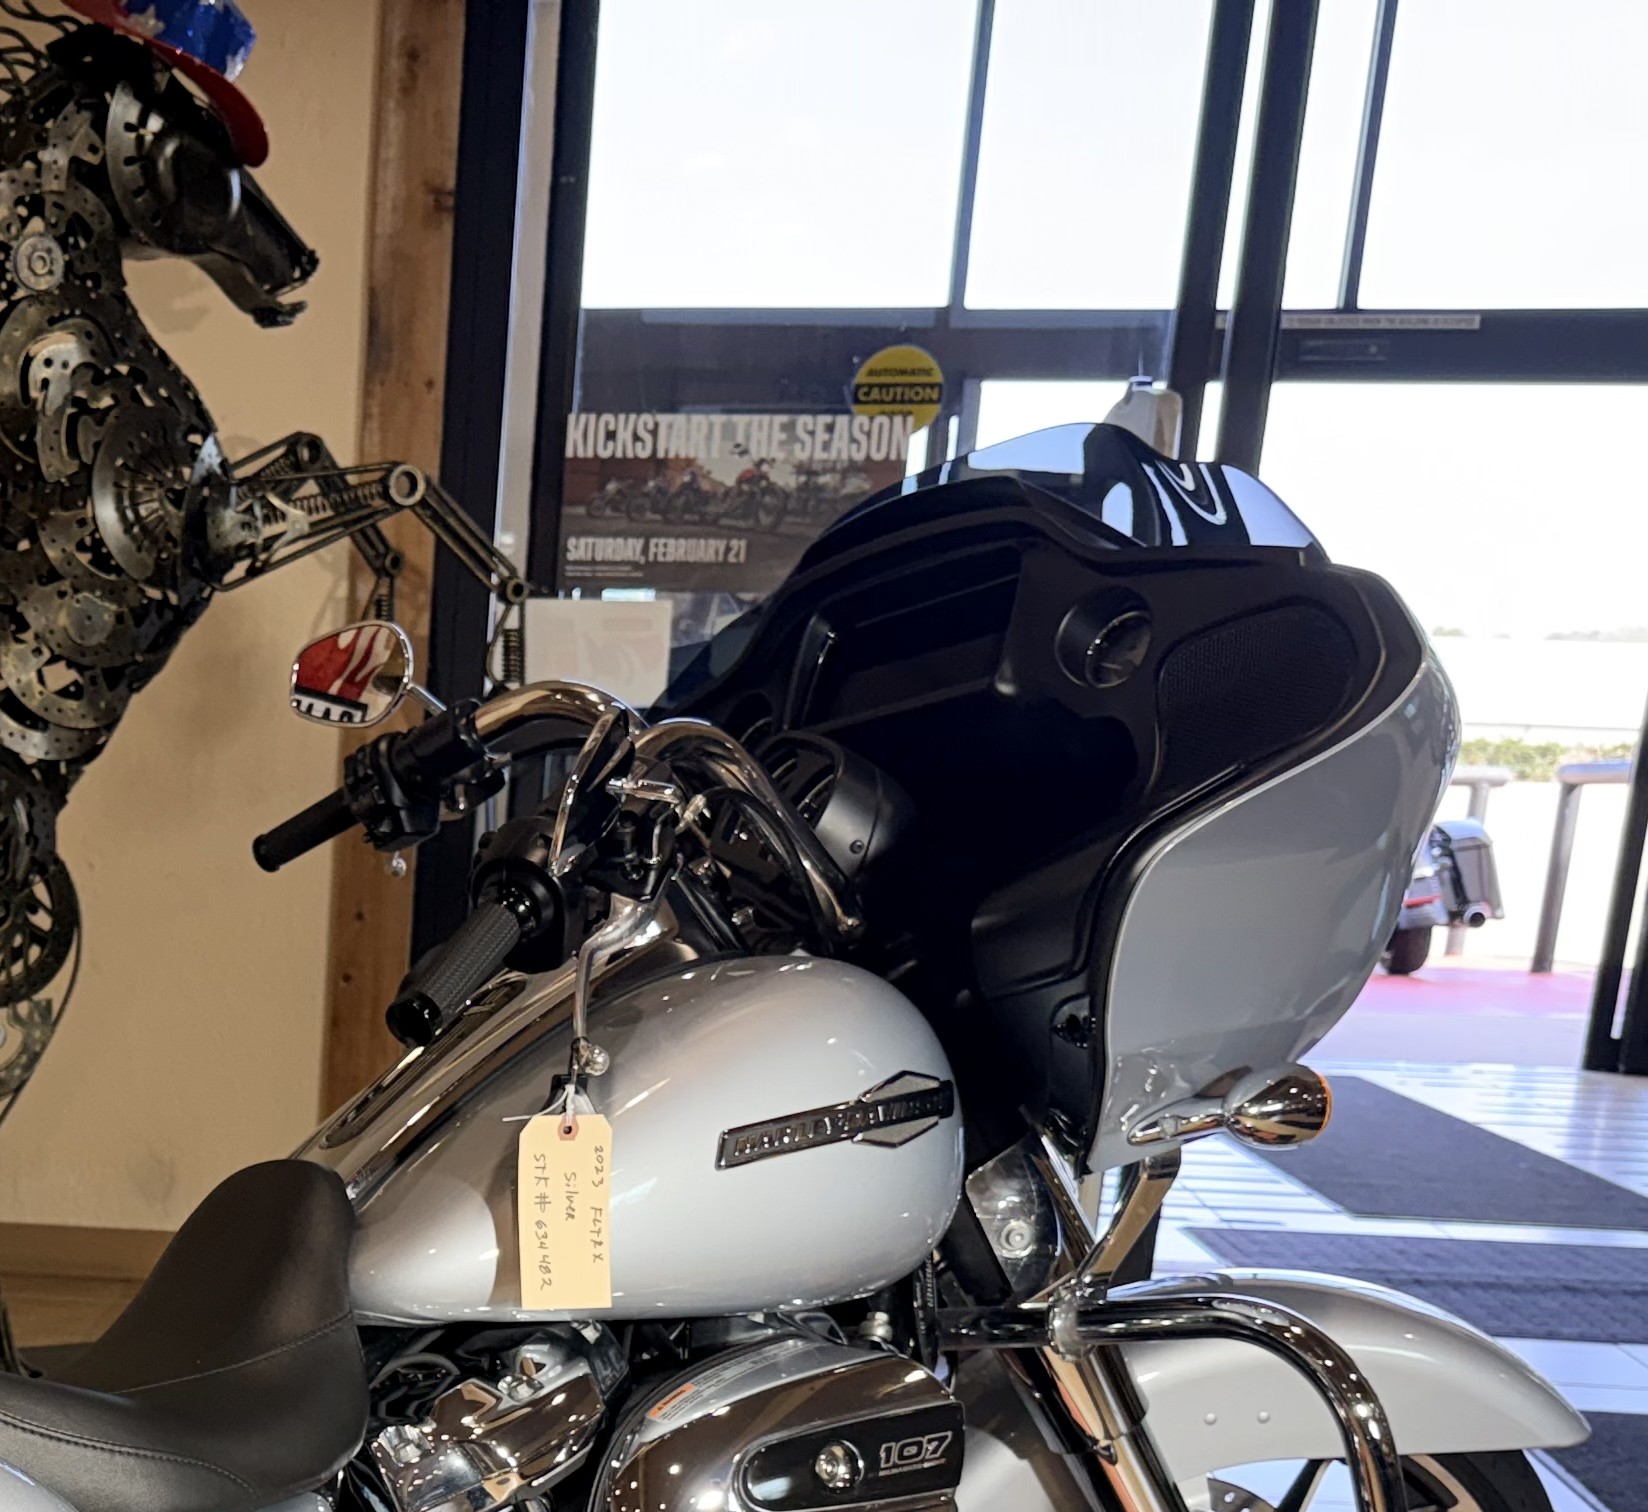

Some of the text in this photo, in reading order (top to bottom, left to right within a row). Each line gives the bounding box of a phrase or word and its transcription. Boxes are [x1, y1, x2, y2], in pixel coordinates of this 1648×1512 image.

[857, 385, 940, 402] CAUTION
[565, 413, 916, 461] KICKSTART THE SEASON
[566, 537, 747, 565] SATURDAY, FEBRUARY 21
[590, 1145, 604, 1263] 2023 FLTRX
[879, 1430, 953, 1469] 107
